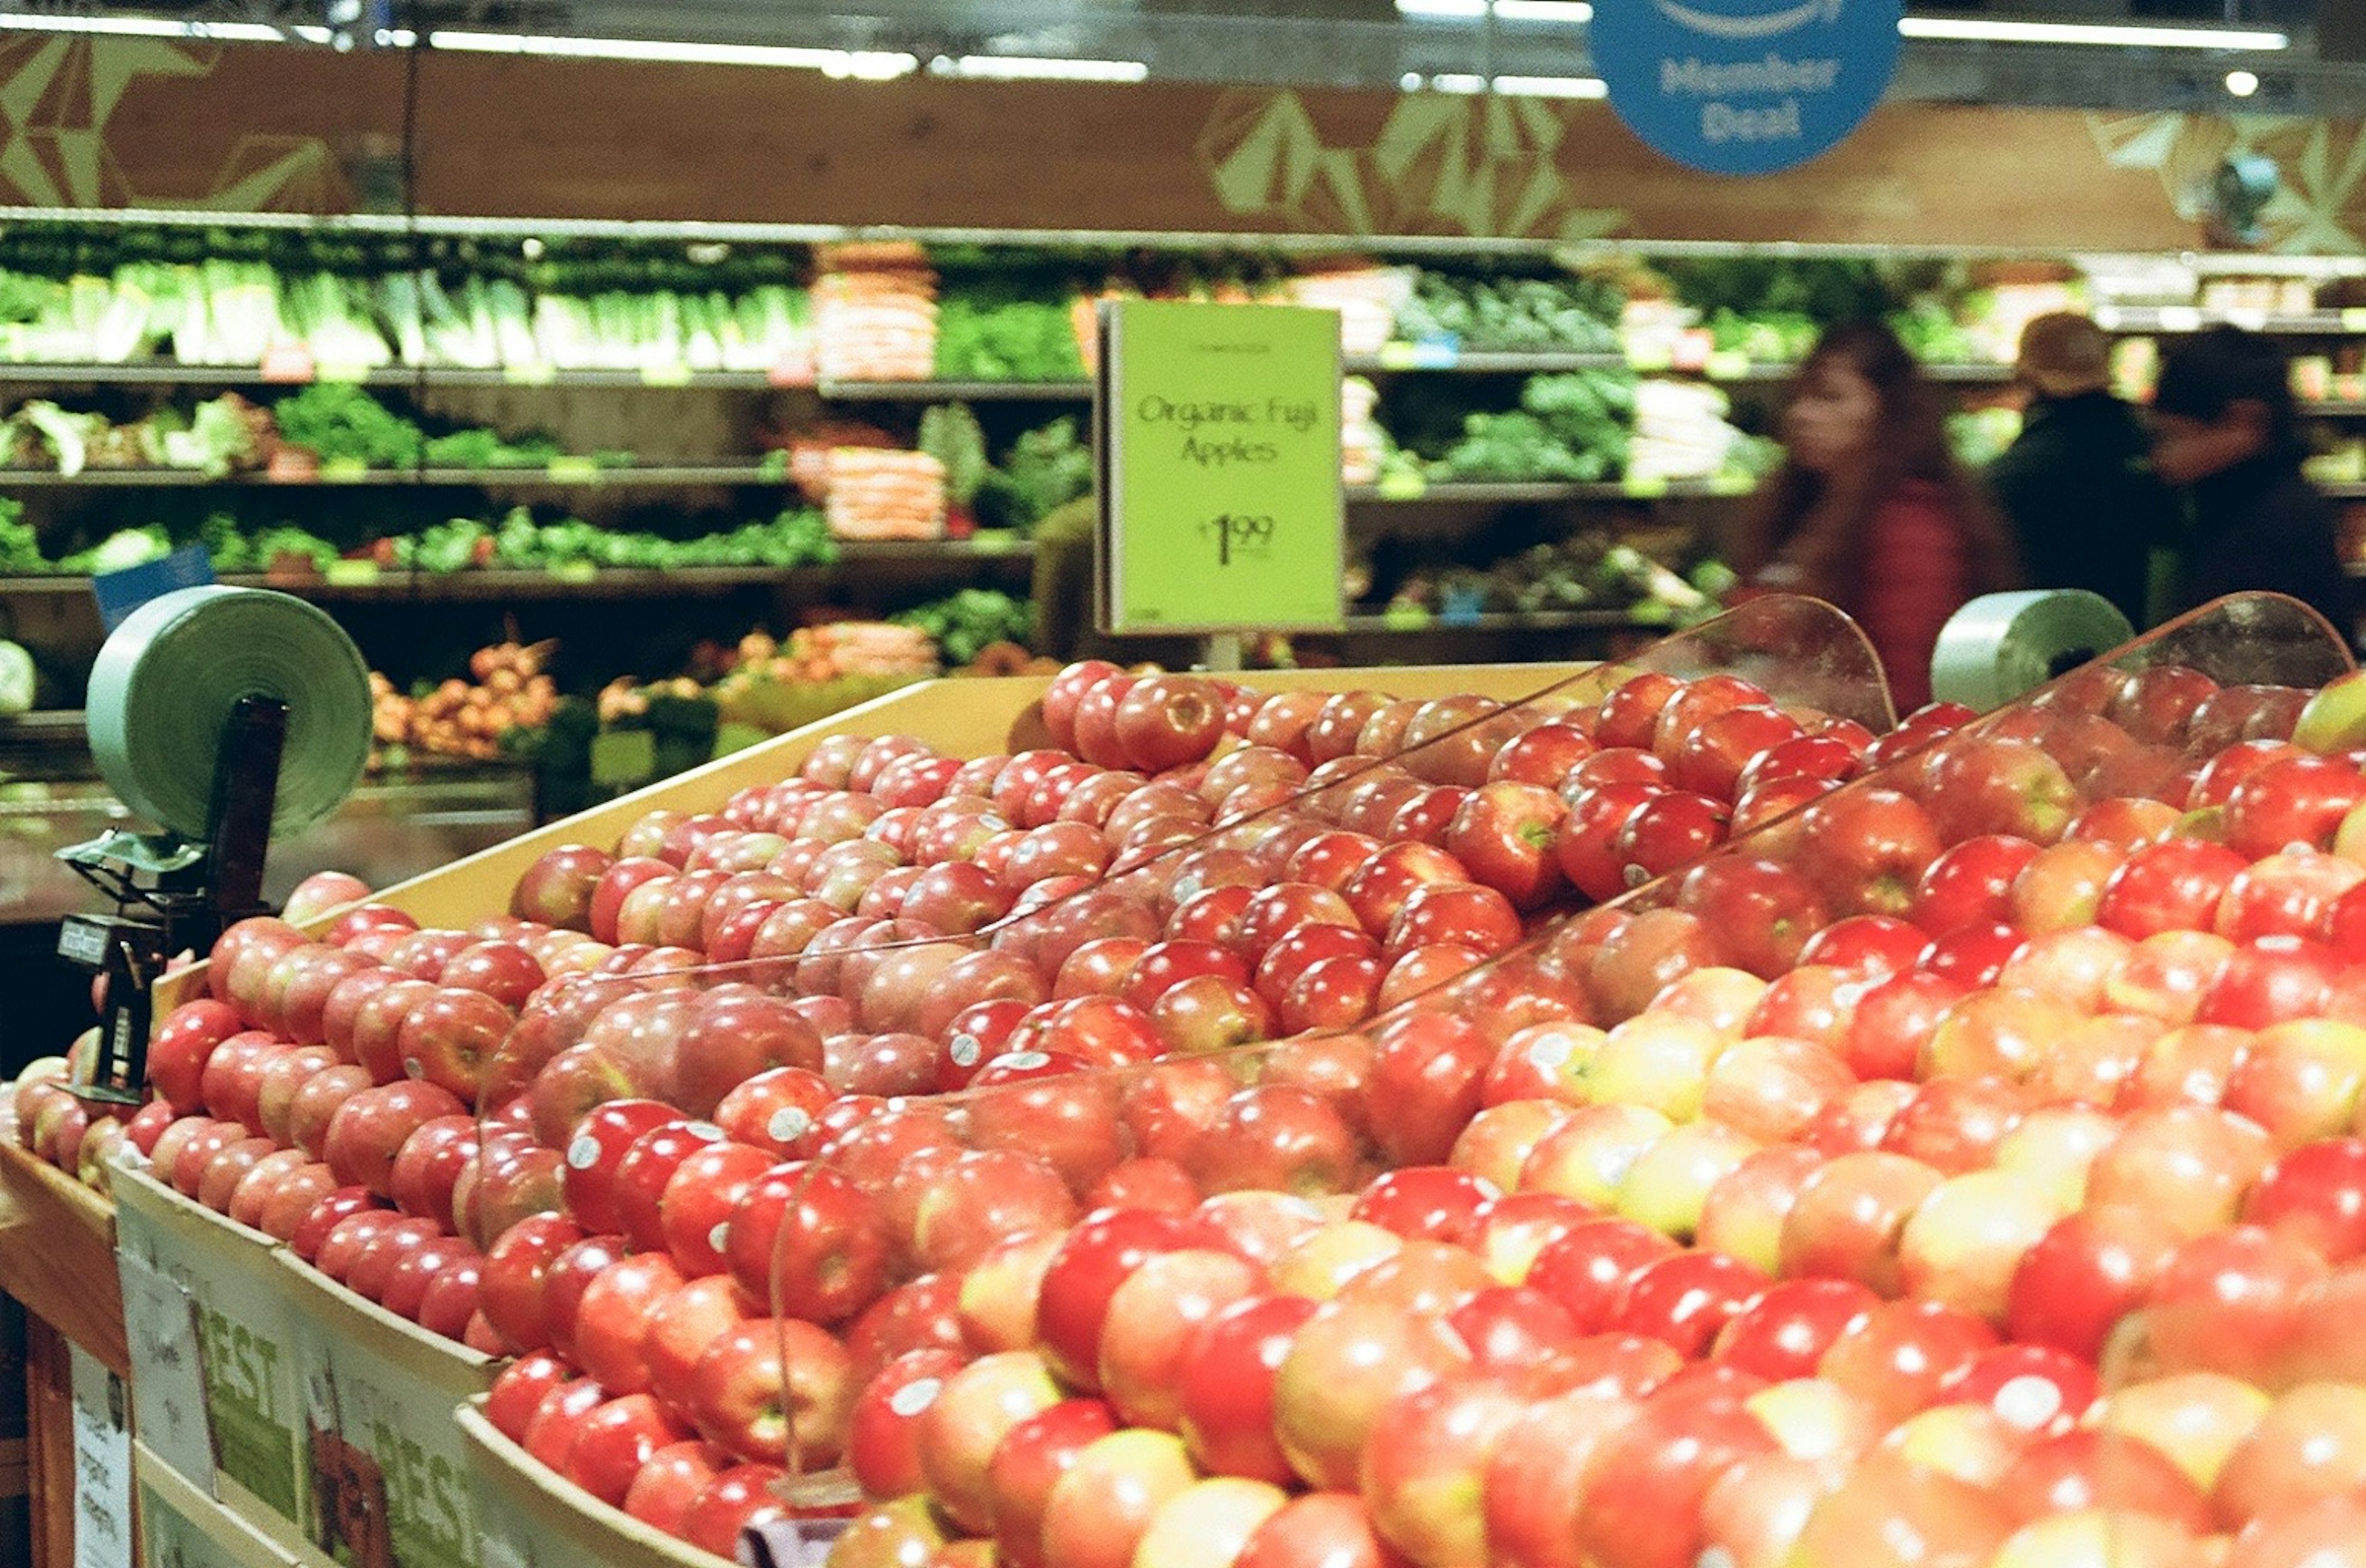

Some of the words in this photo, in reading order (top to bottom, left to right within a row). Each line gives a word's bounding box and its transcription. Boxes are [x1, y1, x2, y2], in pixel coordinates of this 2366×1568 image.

[1660, 53, 1842, 95] Member
[1701, 97, 1802, 143] Deal
[1139, 394, 1256, 431] Organic
[1267, 397, 1319, 433] Fuji
[1181, 436, 1278, 468] Apples
[197, 1301, 277, 1418] EST
